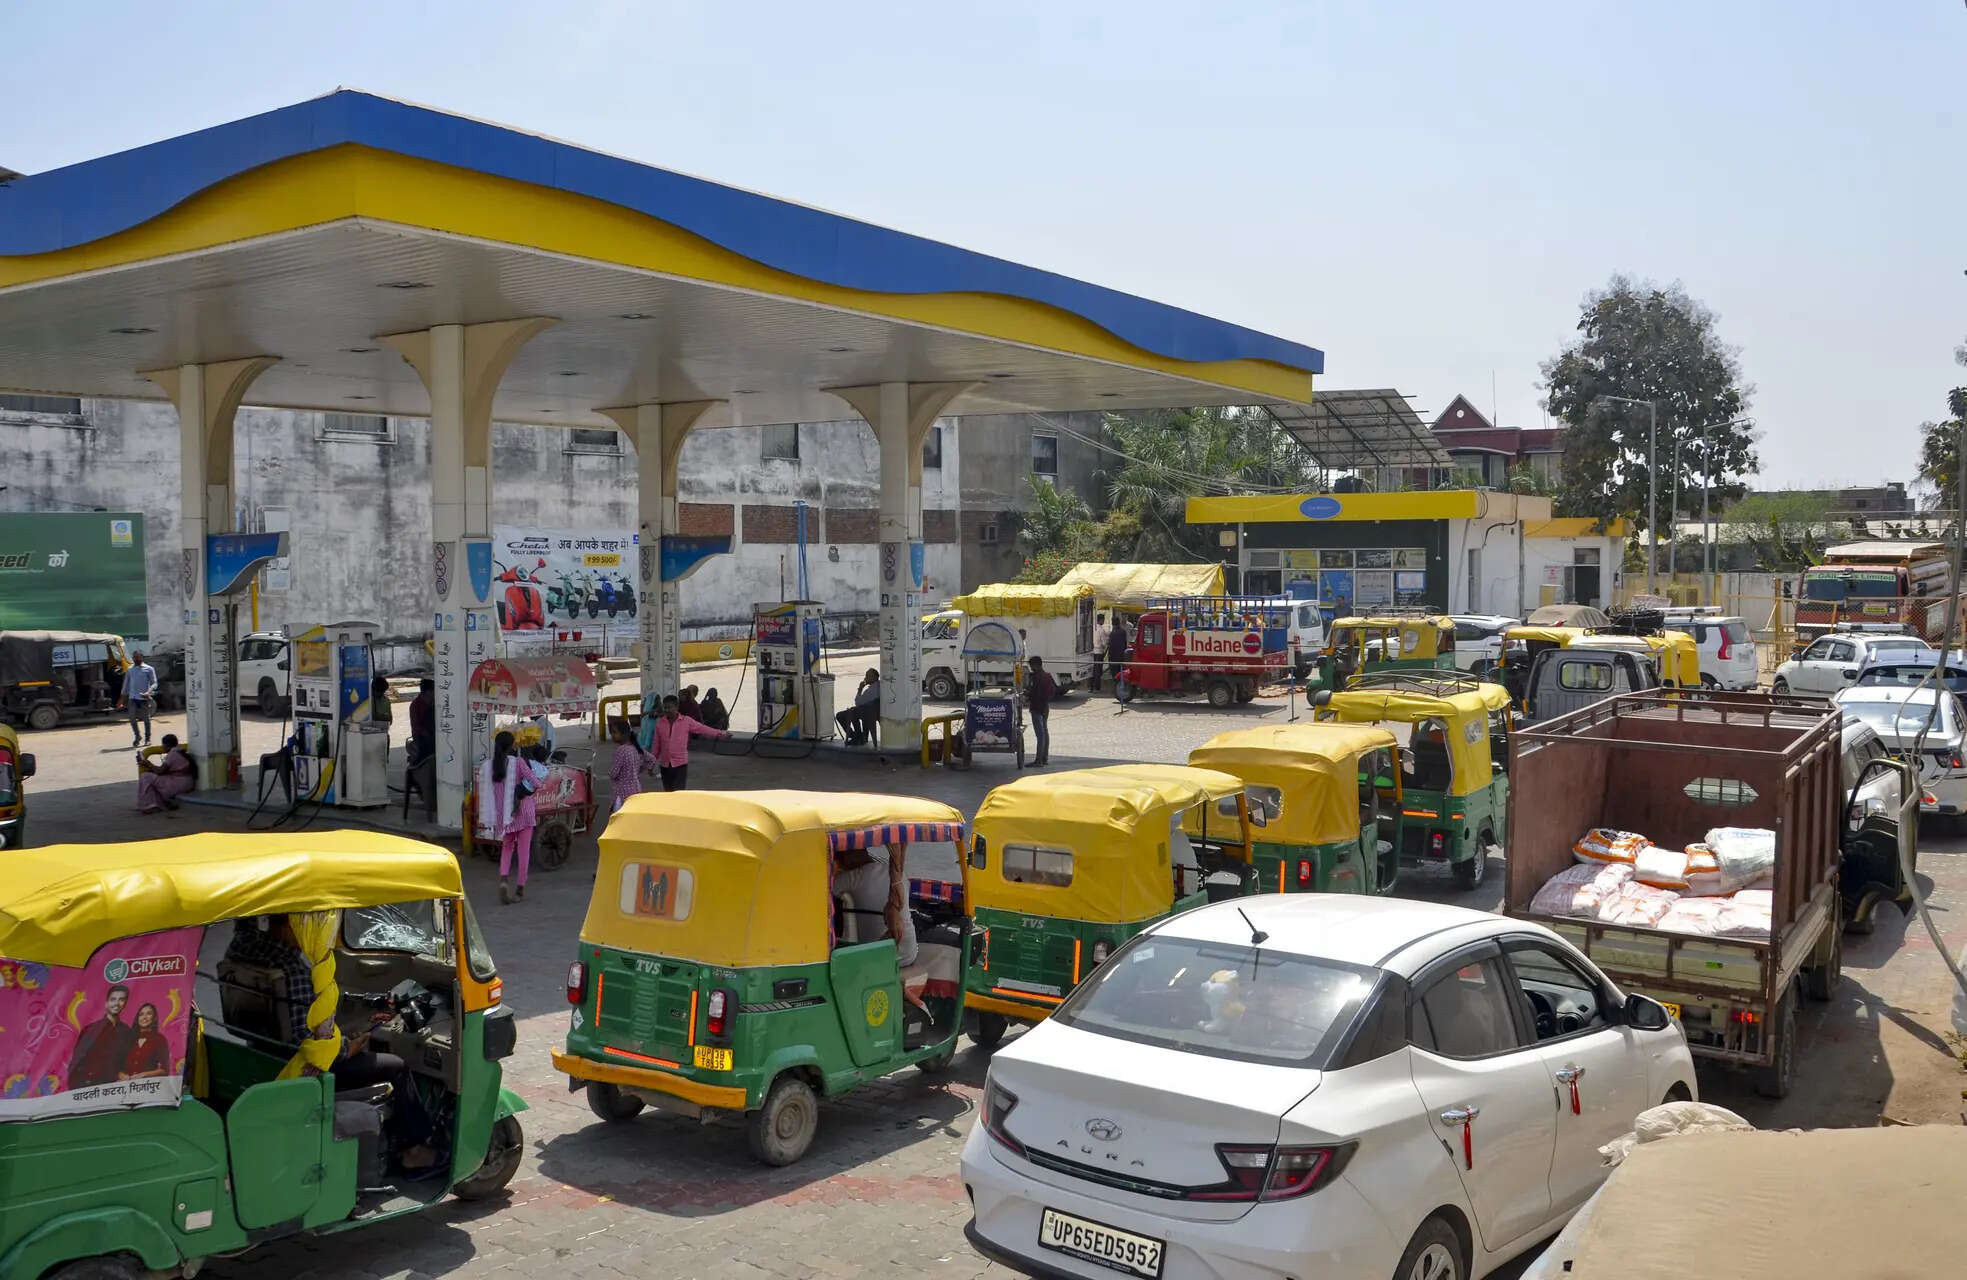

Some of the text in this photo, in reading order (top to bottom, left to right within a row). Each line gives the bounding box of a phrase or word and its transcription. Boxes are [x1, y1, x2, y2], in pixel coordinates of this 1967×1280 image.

[507, 541, 550, 549] Chetak
[558, 539, 572, 550] अब
[575, 537, 599, 550] आपके
[601, 540, 619, 552] शहर
[48, 549, 70, 568] को
[1191, 632, 1241, 653] Indane
[1021, 918, 1045, 930] TVS
[130, 957, 180, 975] Citykart
[634, 959, 662, 975] TVS
[1057, 1139, 1145, 1167] AURA
[1053, 1218, 1159, 1270] UP65ED5952
